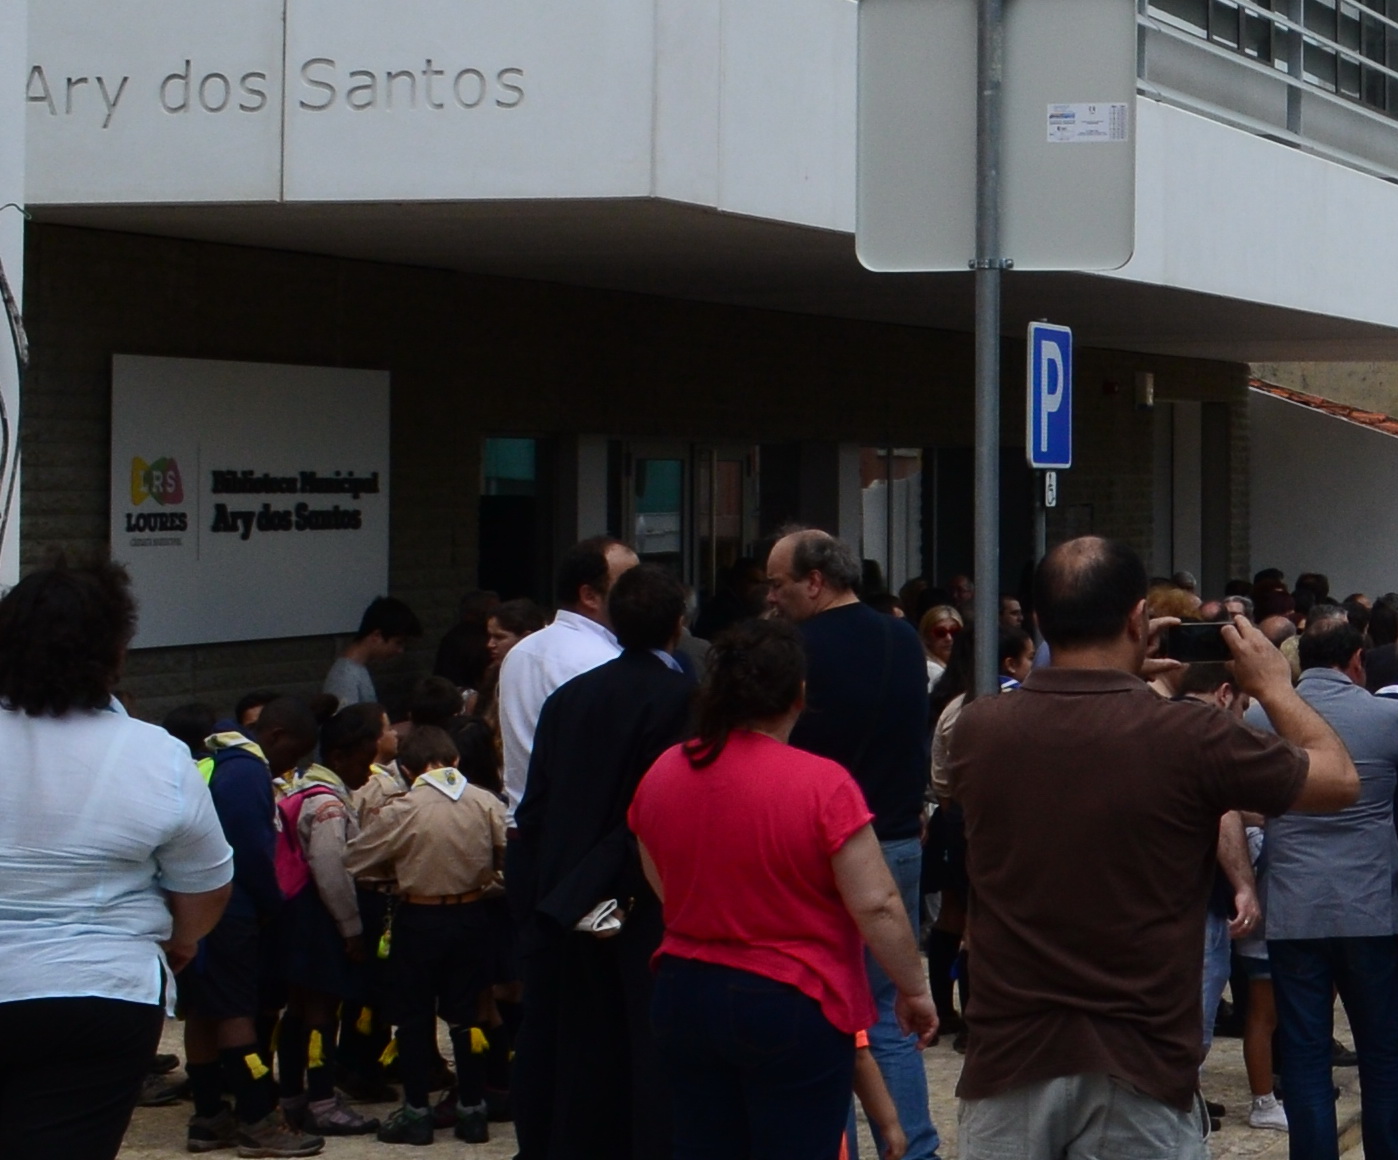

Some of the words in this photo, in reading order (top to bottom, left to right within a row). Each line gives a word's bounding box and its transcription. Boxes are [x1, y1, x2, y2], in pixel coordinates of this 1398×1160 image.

[26, 65, 129, 128] Ary
[160, 59, 268, 113] dos
[299, 57, 525, 113] Santos
[1041, 340, 1064, 452] P
[211, 469, 298, 493] Biblioteca
[299, 471, 380, 500] Municipal
[125, 512, 188, 533] LOURES
[211, 503, 255, 541] Ary
[256, 503, 293, 532] dos
[294, 502, 362, 531] Santos
